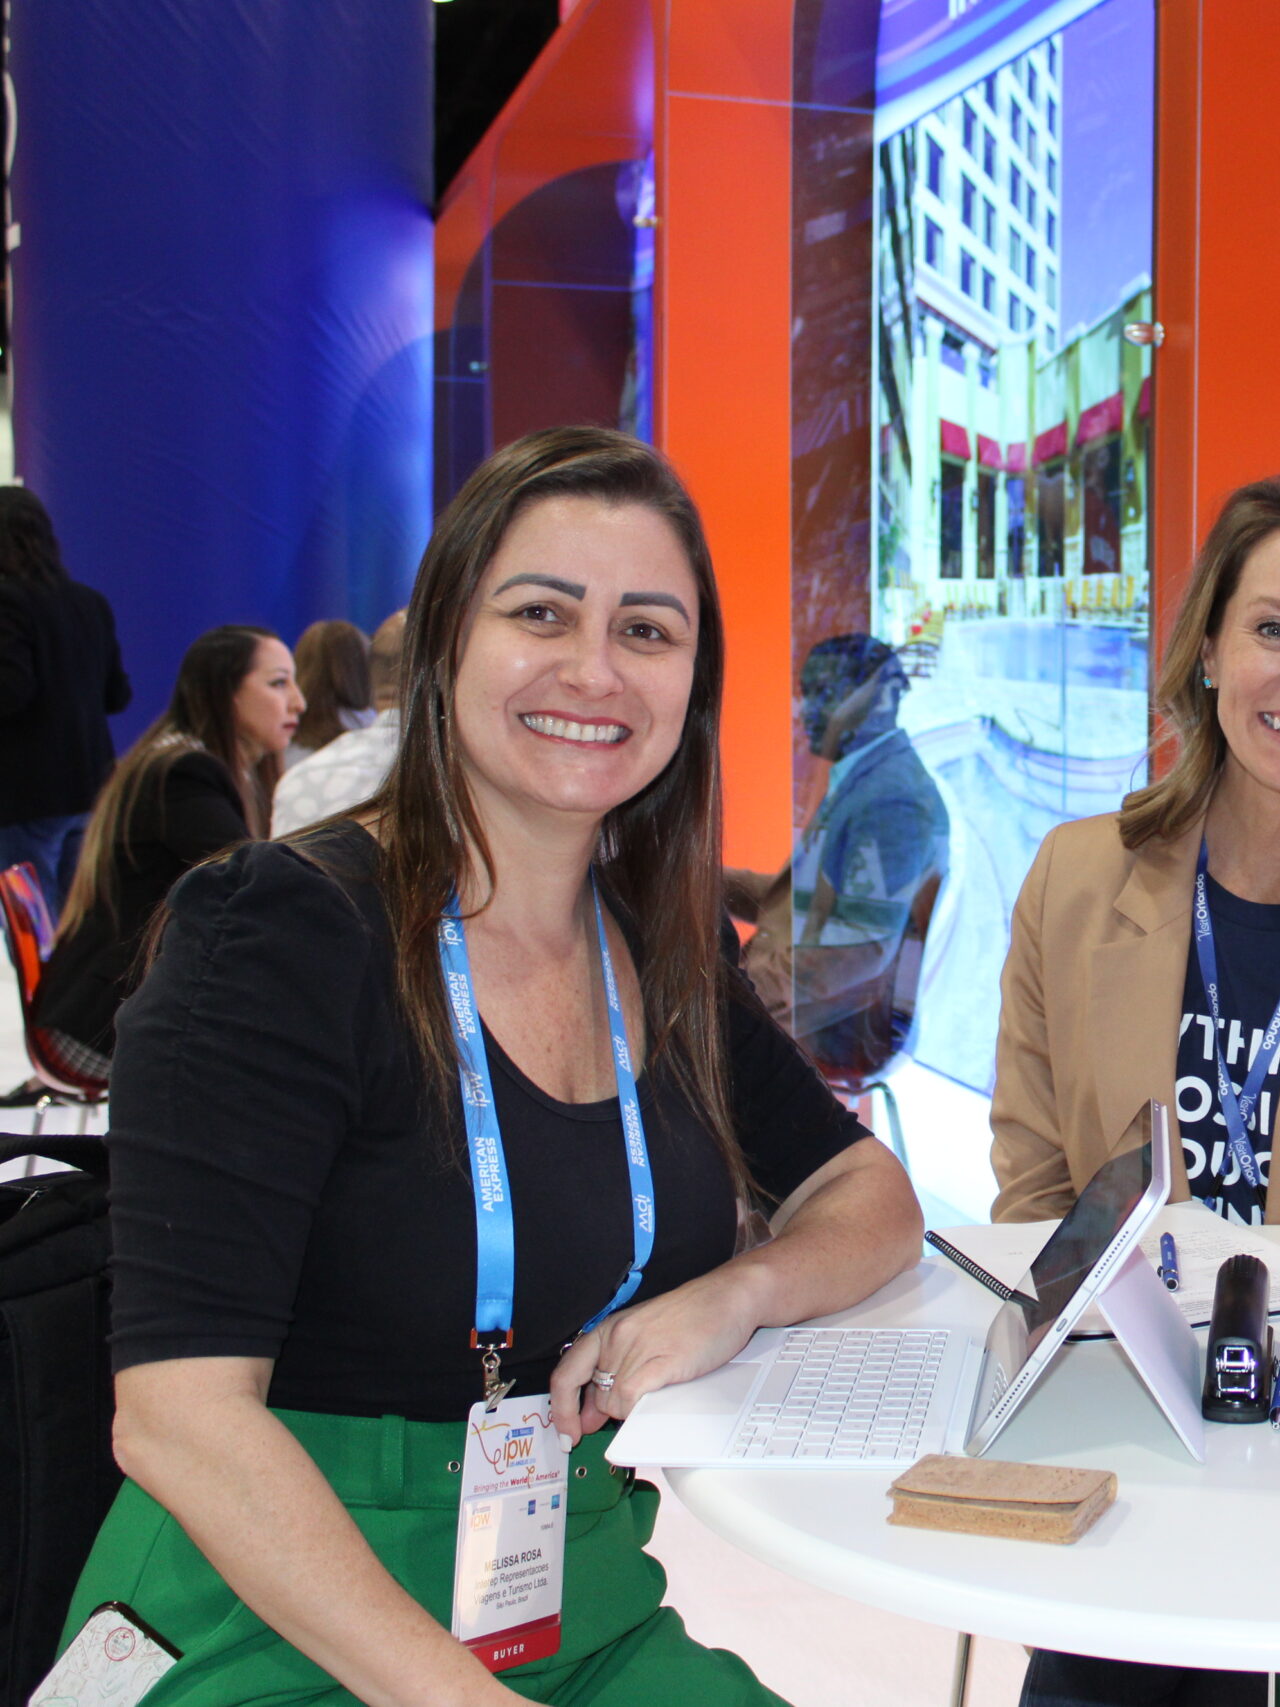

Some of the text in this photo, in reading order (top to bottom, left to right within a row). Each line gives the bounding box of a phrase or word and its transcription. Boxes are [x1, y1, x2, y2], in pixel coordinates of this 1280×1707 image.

[448, 971, 469, 1041] AMERICAN
[457, 973, 477, 1034] EXPRESS
[623, 1104, 639, 1165] EXPRESS
[628, 1098, 646, 1168] AMERICAN
[474, 1136, 495, 1212] AMERICAN
[485, 1137, 505, 1203] EXPRESS
[500, 1480, 509, 1488] the
[510, 1477, 528, 1486] World
[503, 1437, 533, 1468] ipw
[521, 1548, 542, 1563] ROSA
[493, 1643, 525, 1661] BUYER
